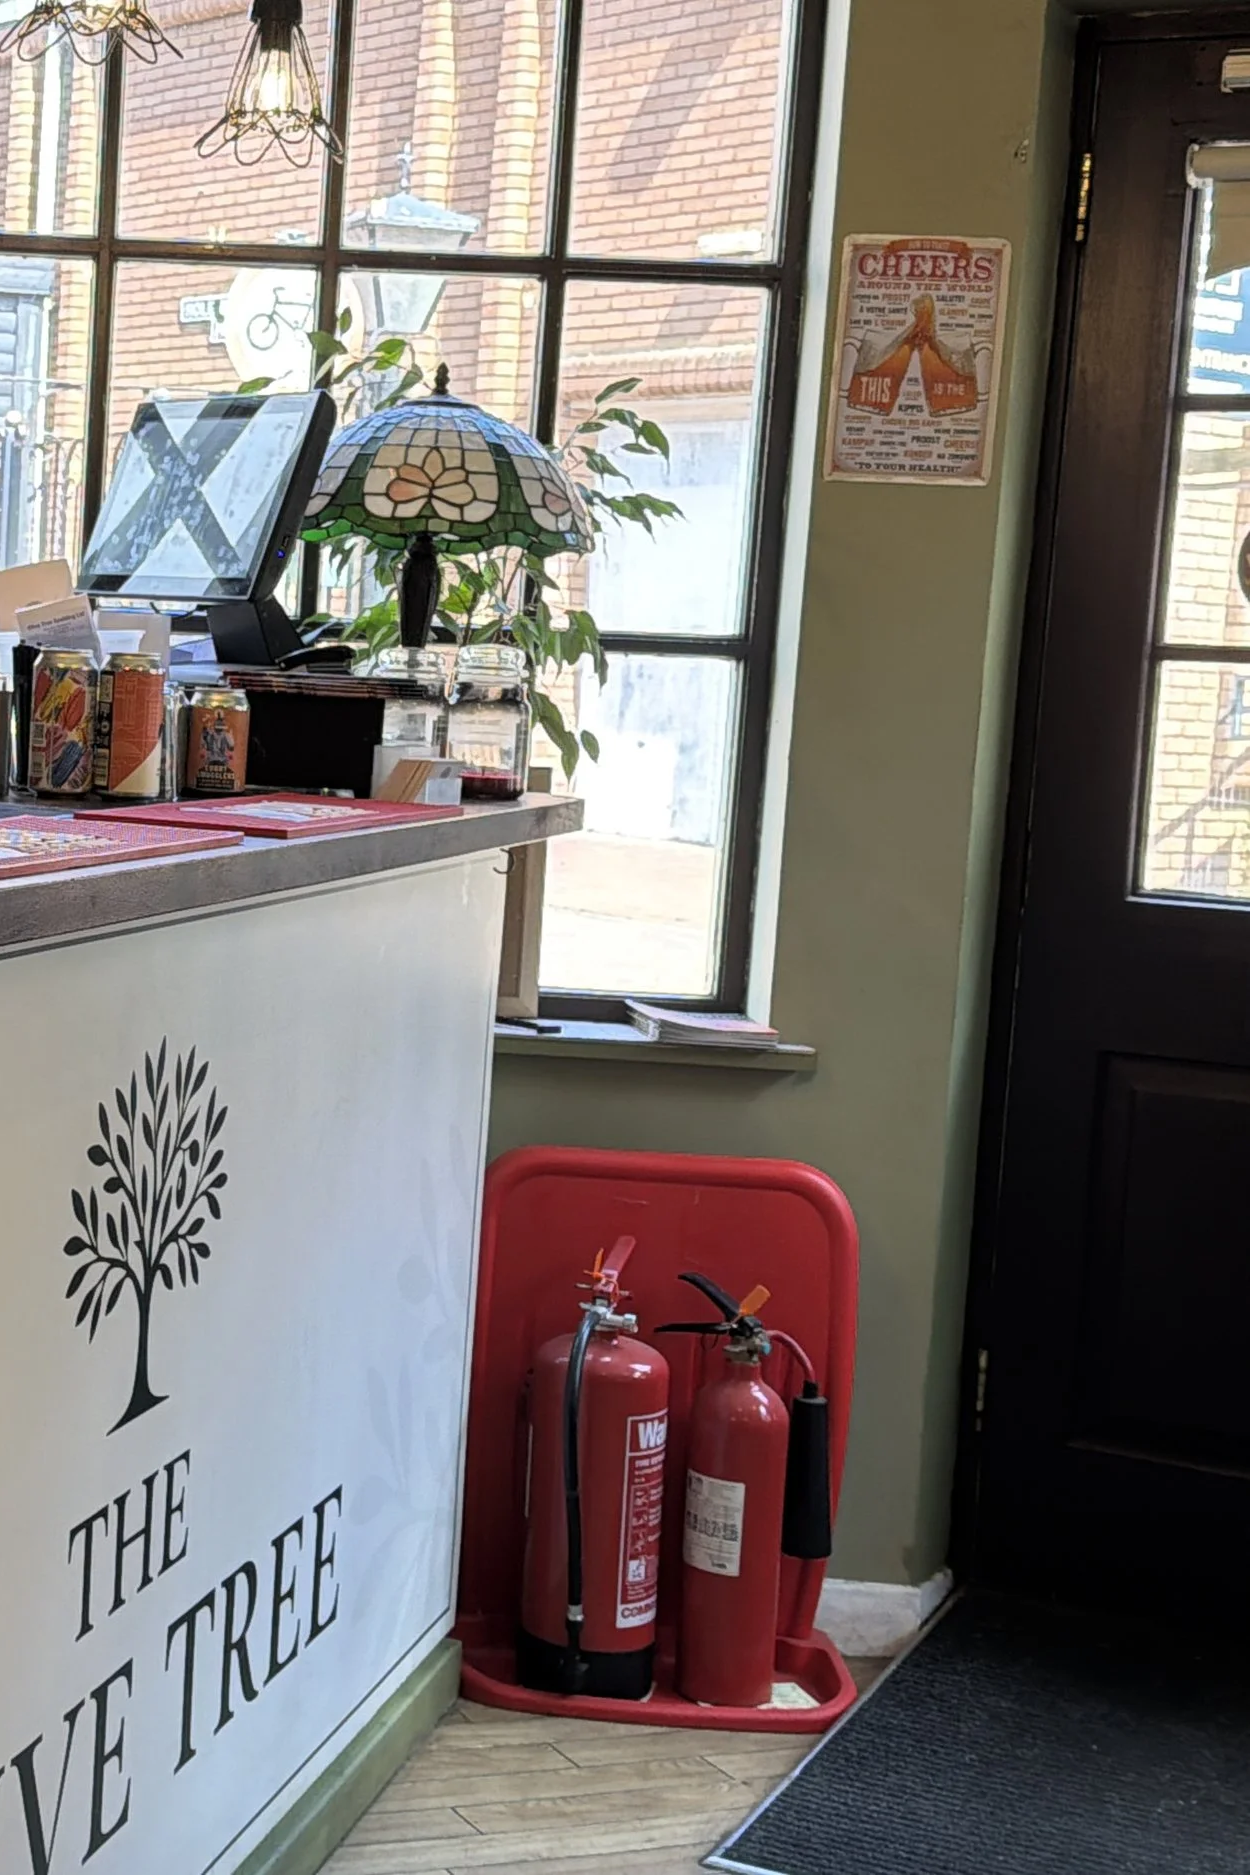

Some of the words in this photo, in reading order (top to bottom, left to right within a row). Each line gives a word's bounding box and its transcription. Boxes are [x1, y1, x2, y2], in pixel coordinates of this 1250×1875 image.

[858, 253, 994, 282] CHEERS
[857, 281, 911, 291] AROUND
[917, 283, 942, 291] THE
[946, 284, 993, 293] WORLD
[861, 376, 890, 403] THIS
[933, 383, 944, 395] IS
[946, 383, 966, 396] THE
[874, 463, 906, 472] YOUR
[638, 1420, 667, 1449] Wa
[68, 1449, 191, 1643] THE
[164, 1483, 344, 1776] TREE
